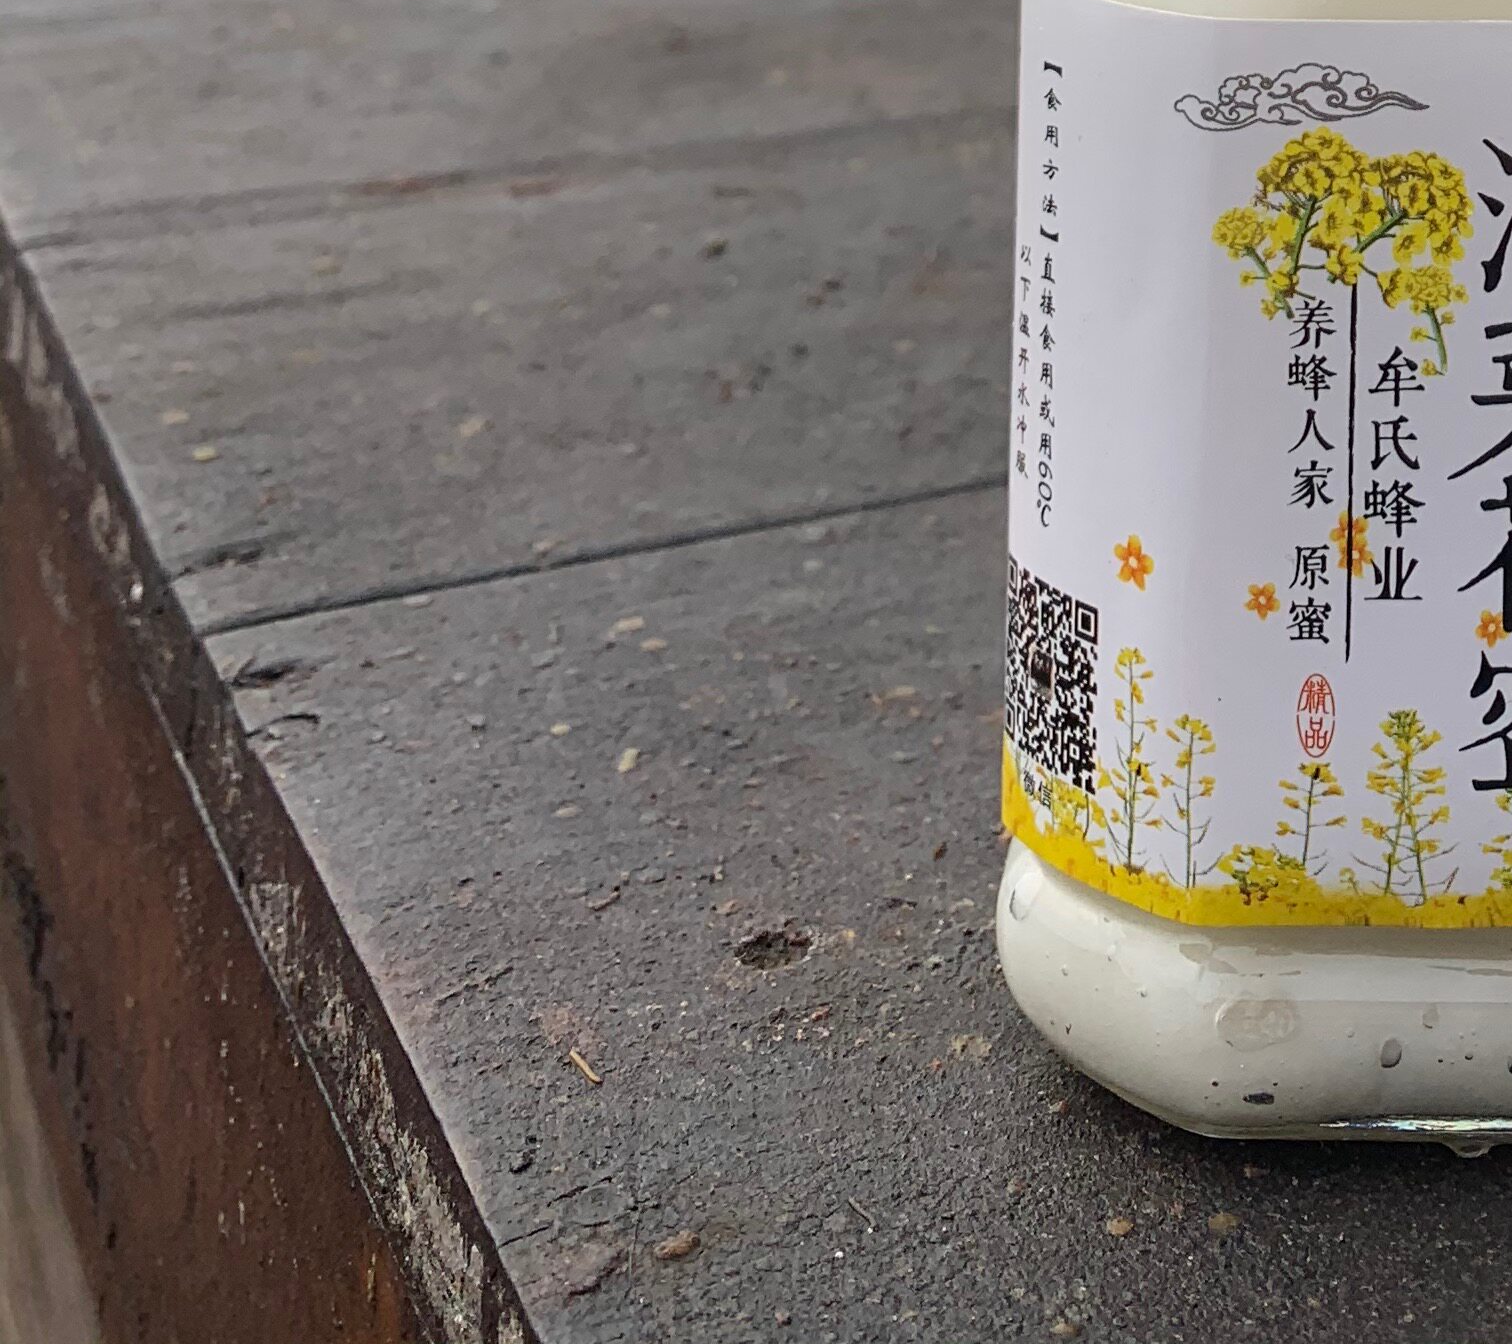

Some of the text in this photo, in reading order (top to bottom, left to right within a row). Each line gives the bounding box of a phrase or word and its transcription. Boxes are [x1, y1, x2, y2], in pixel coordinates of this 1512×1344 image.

[1286, 298, 1338, 645] 养蜂人家 原蜜
[1363, 345, 1426, 602] 牟氏蜂业
[1300, 677, 1333, 752] 精品
